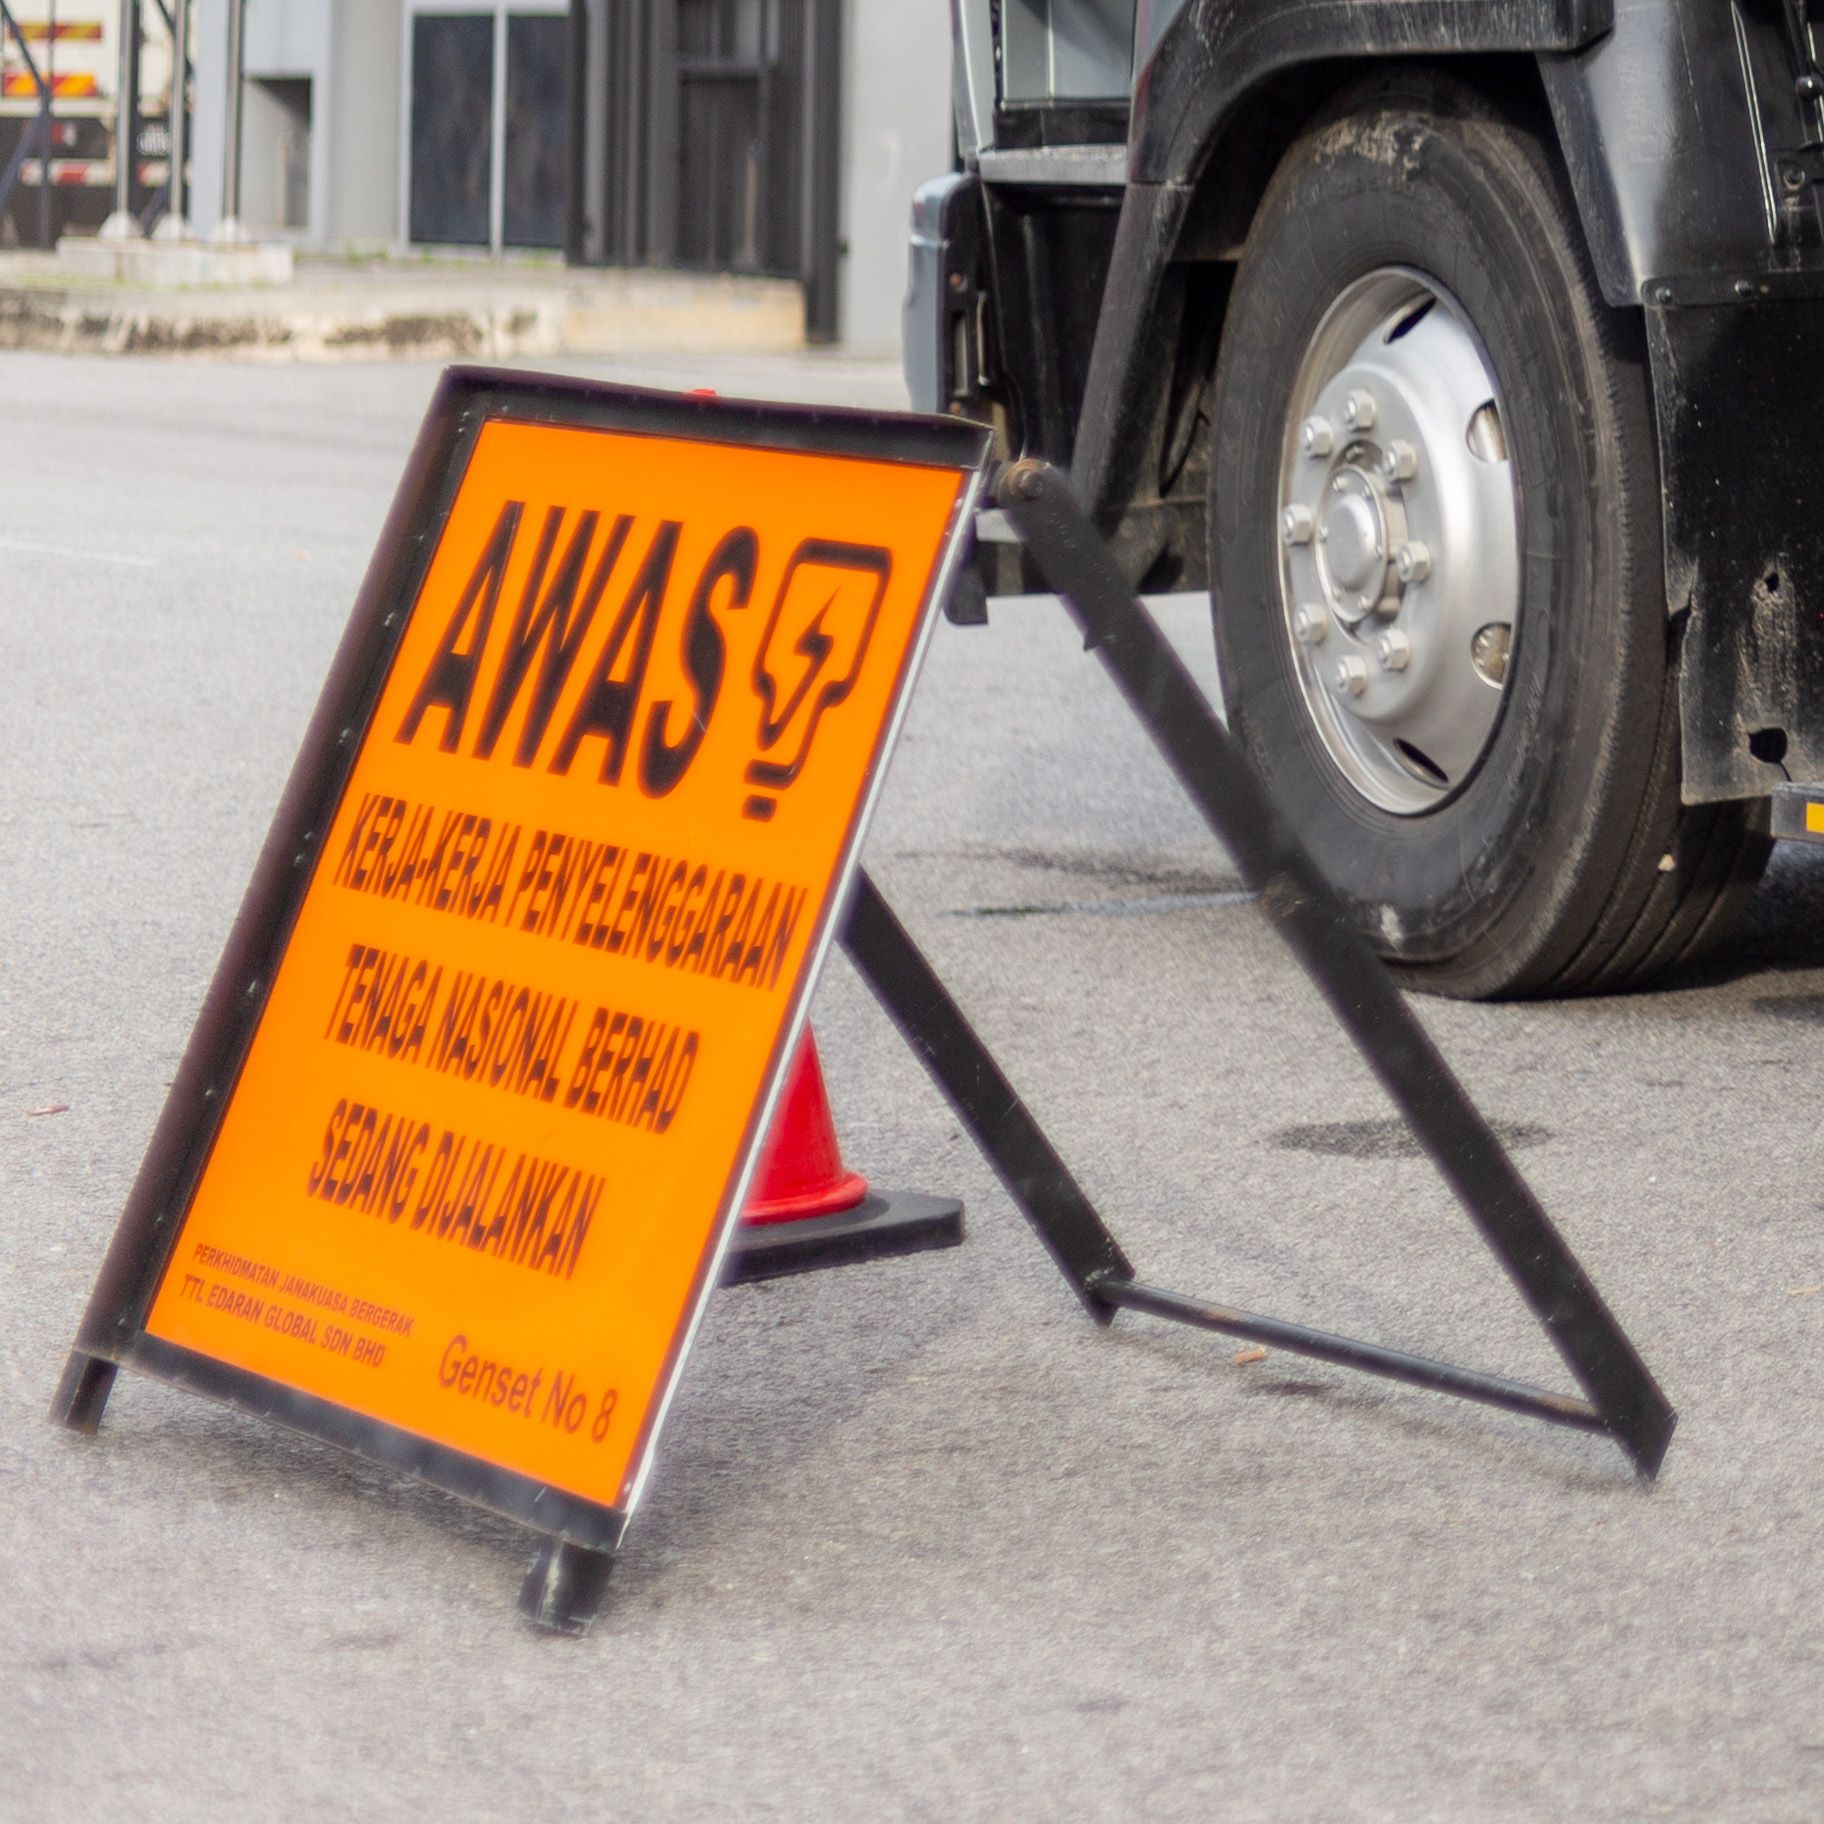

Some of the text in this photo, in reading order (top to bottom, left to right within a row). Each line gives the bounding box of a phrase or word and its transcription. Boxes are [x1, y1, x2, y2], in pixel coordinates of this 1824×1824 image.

[393, 499, 760, 800] AWAS
[332, 791, 809, 992] KERJA-KERJA PENYELENGGARAAN
[323, 942, 702, 1136] TENAGA NASIONAL BERHAD
[305, 1097, 608, 1282] SEDANG DIJALANKAN
[179, 1274, 386, 1369] TTL EDARAN GLOBAL SDN BHD
[192, 1242, 416, 1339] PERKHIDMATAN JANAKUASA BERGERAK
[438, 1333, 619, 1445] Genset No 8
